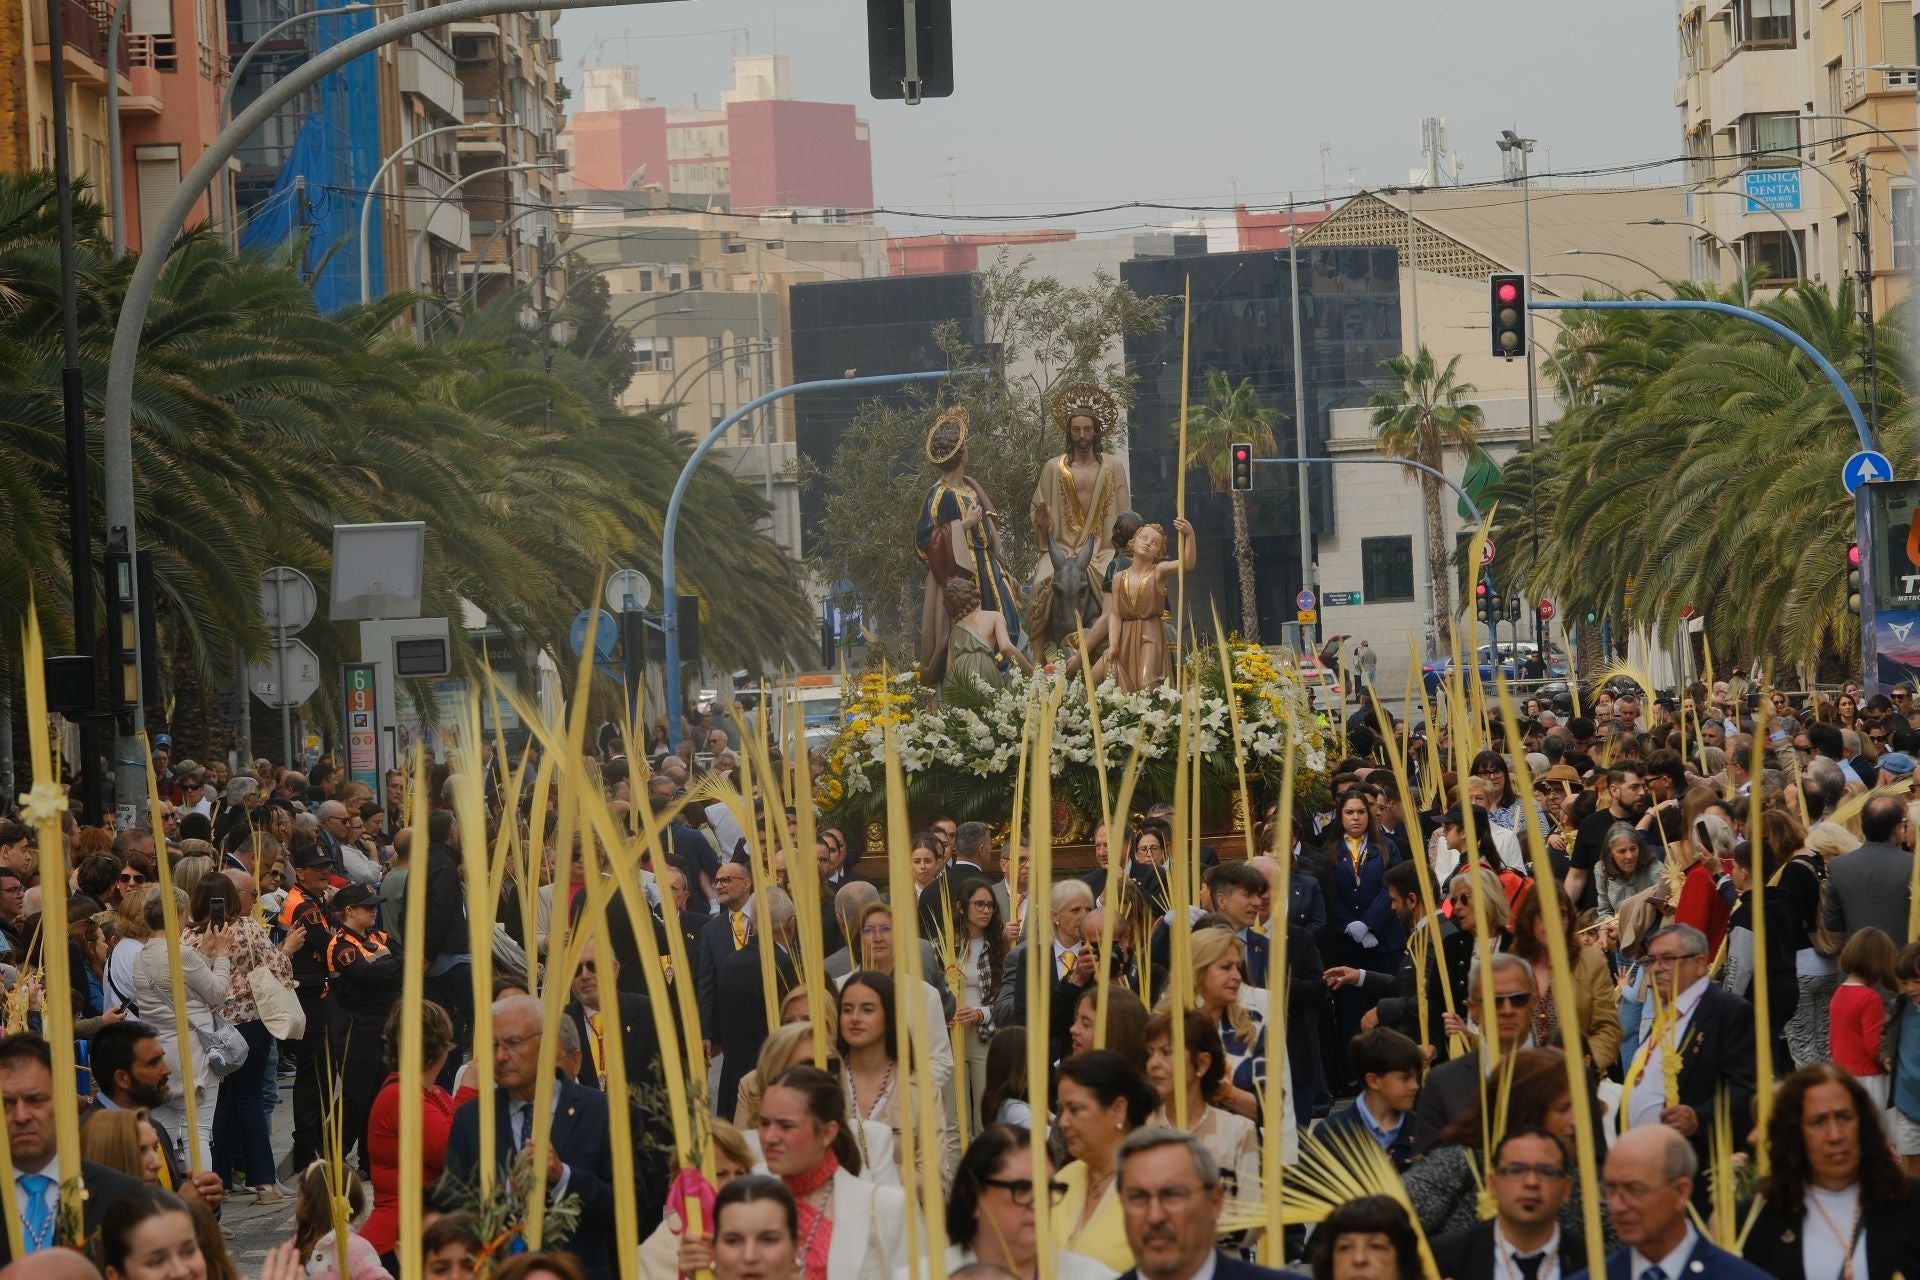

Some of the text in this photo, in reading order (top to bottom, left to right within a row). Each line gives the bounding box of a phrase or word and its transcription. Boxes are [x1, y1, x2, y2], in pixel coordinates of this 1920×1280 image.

[1747, 172, 1798, 183] CLINICA
[1749, 184, 1798, 196] DENTAL
[355, 670, 365, 690] 6
[355, 690, 365, 711] 9
